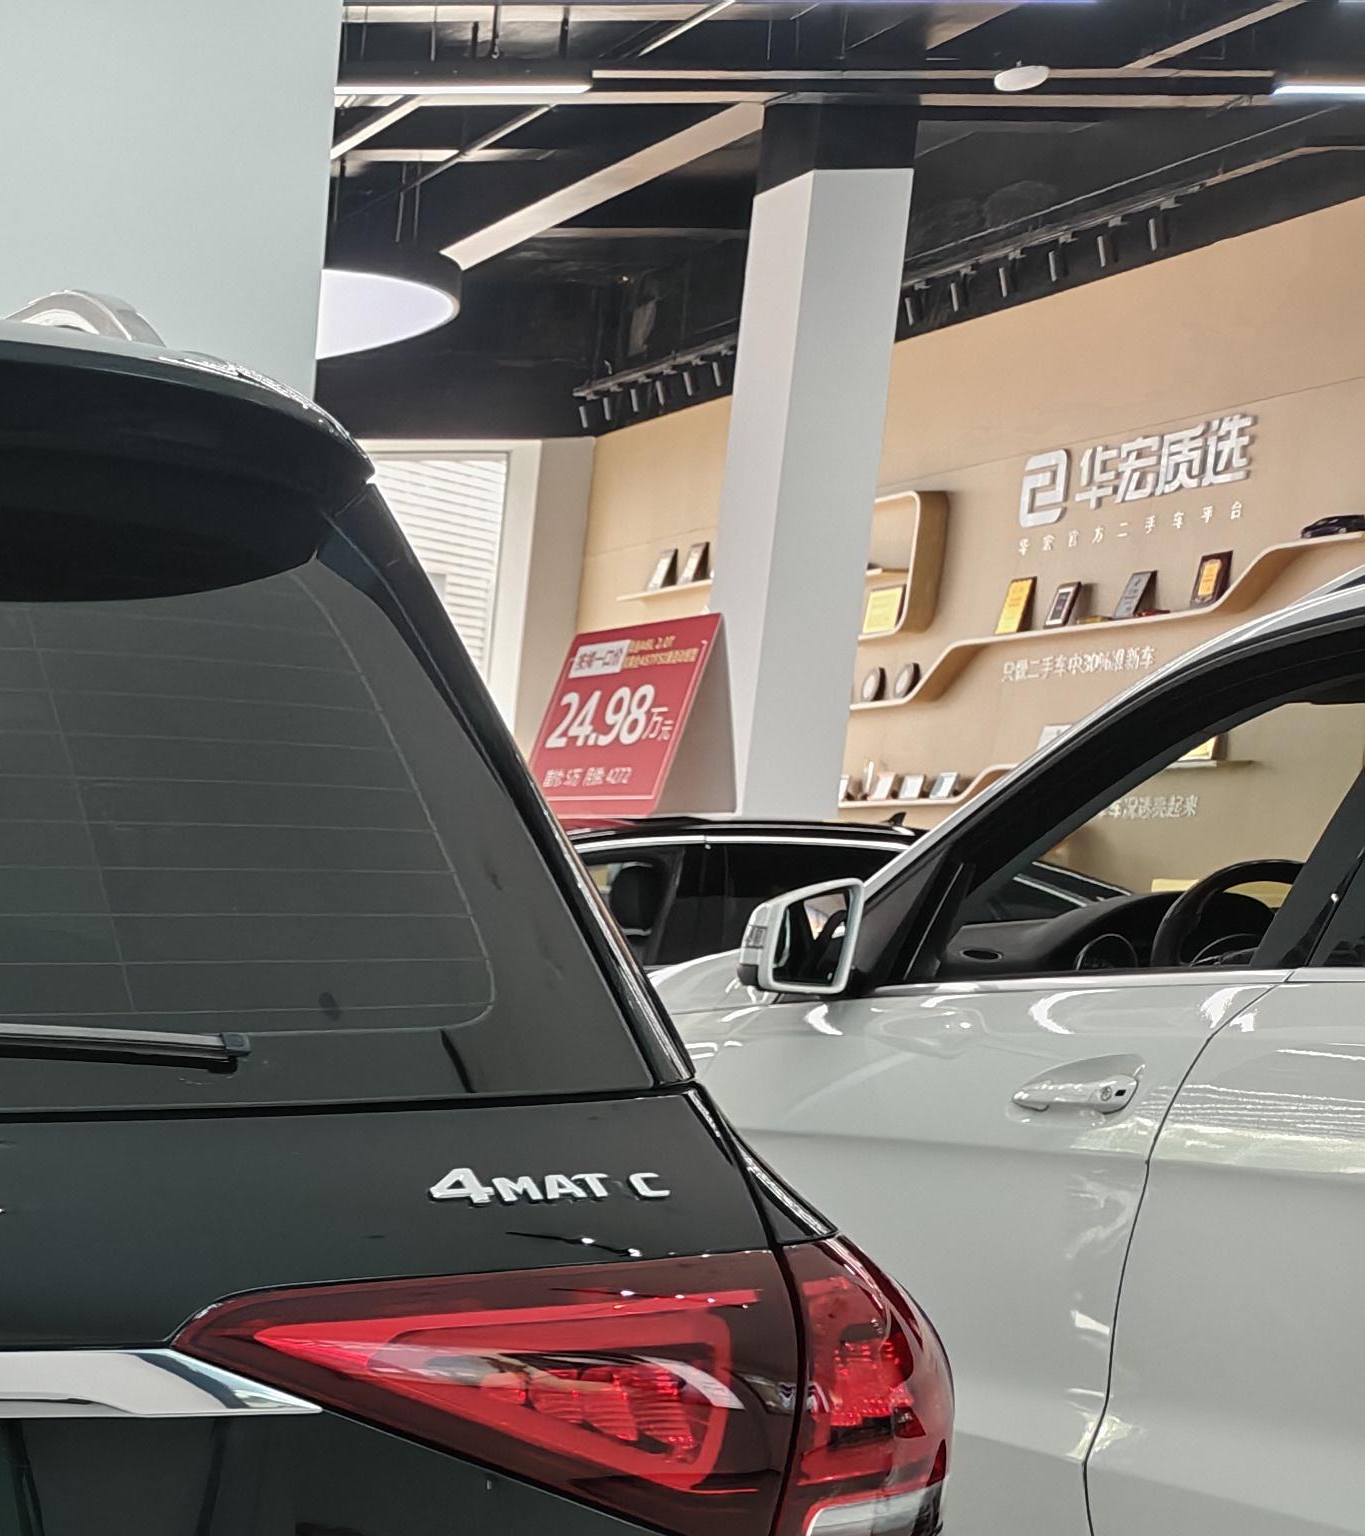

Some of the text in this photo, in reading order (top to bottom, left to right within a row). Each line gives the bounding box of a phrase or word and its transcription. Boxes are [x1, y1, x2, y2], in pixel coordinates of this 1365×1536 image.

[1074, 413, 1253, 510] 华宏质选
[545, 684, 655, 748] 24.98
